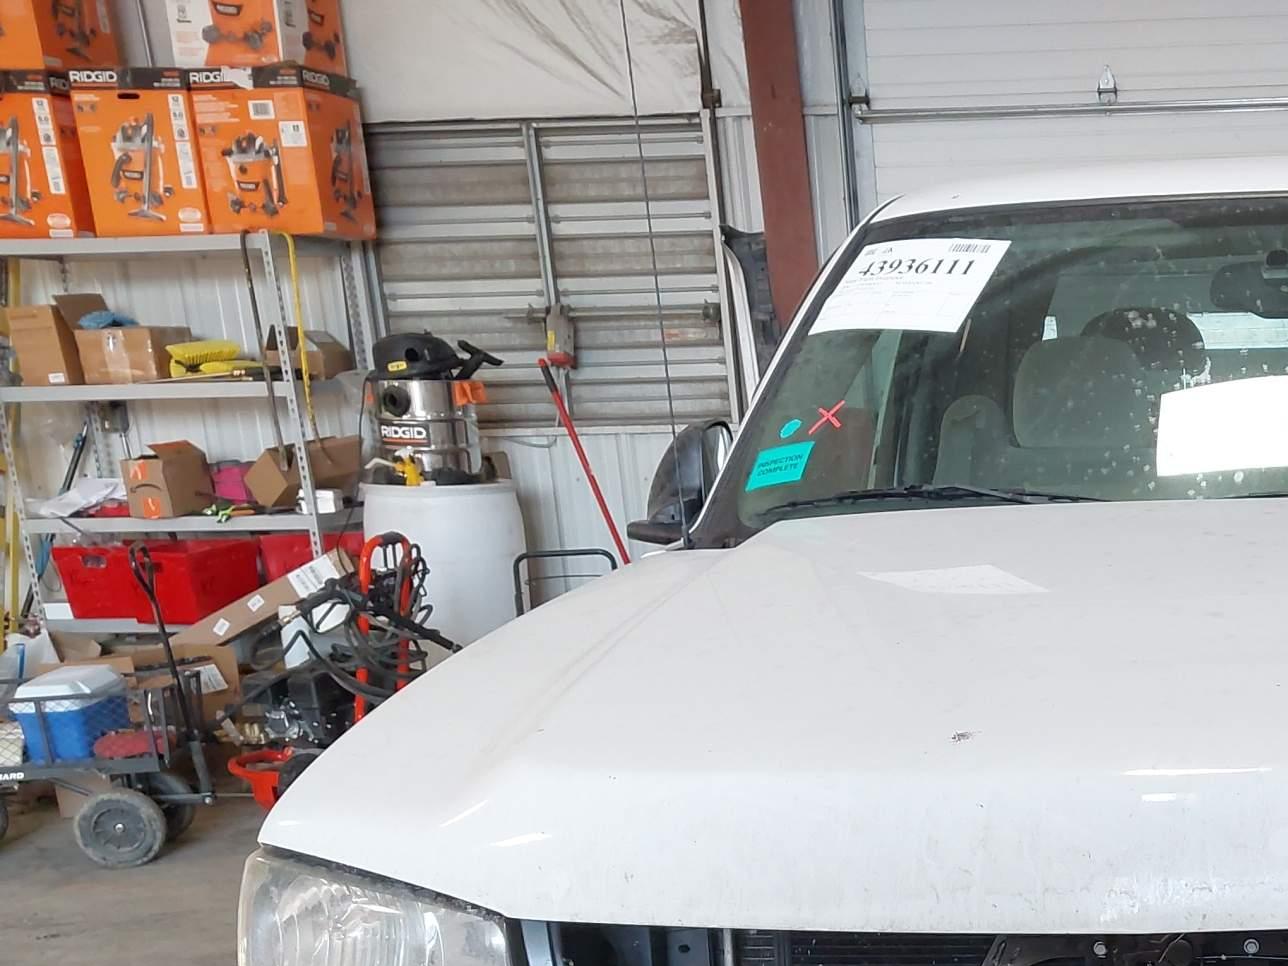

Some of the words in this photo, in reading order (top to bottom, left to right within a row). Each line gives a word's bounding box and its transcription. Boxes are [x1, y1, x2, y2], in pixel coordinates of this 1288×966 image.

[69, 71, 117, 83] RIDGID
[189, 71, 225, 83] RIDGI
[858, 257, 976, 277] 43936111
[381, 425, 427, 438] RIDGID
[758, 454, 803, 468] INSPECTION
[757, 463, 799, 477] COMPLETE
